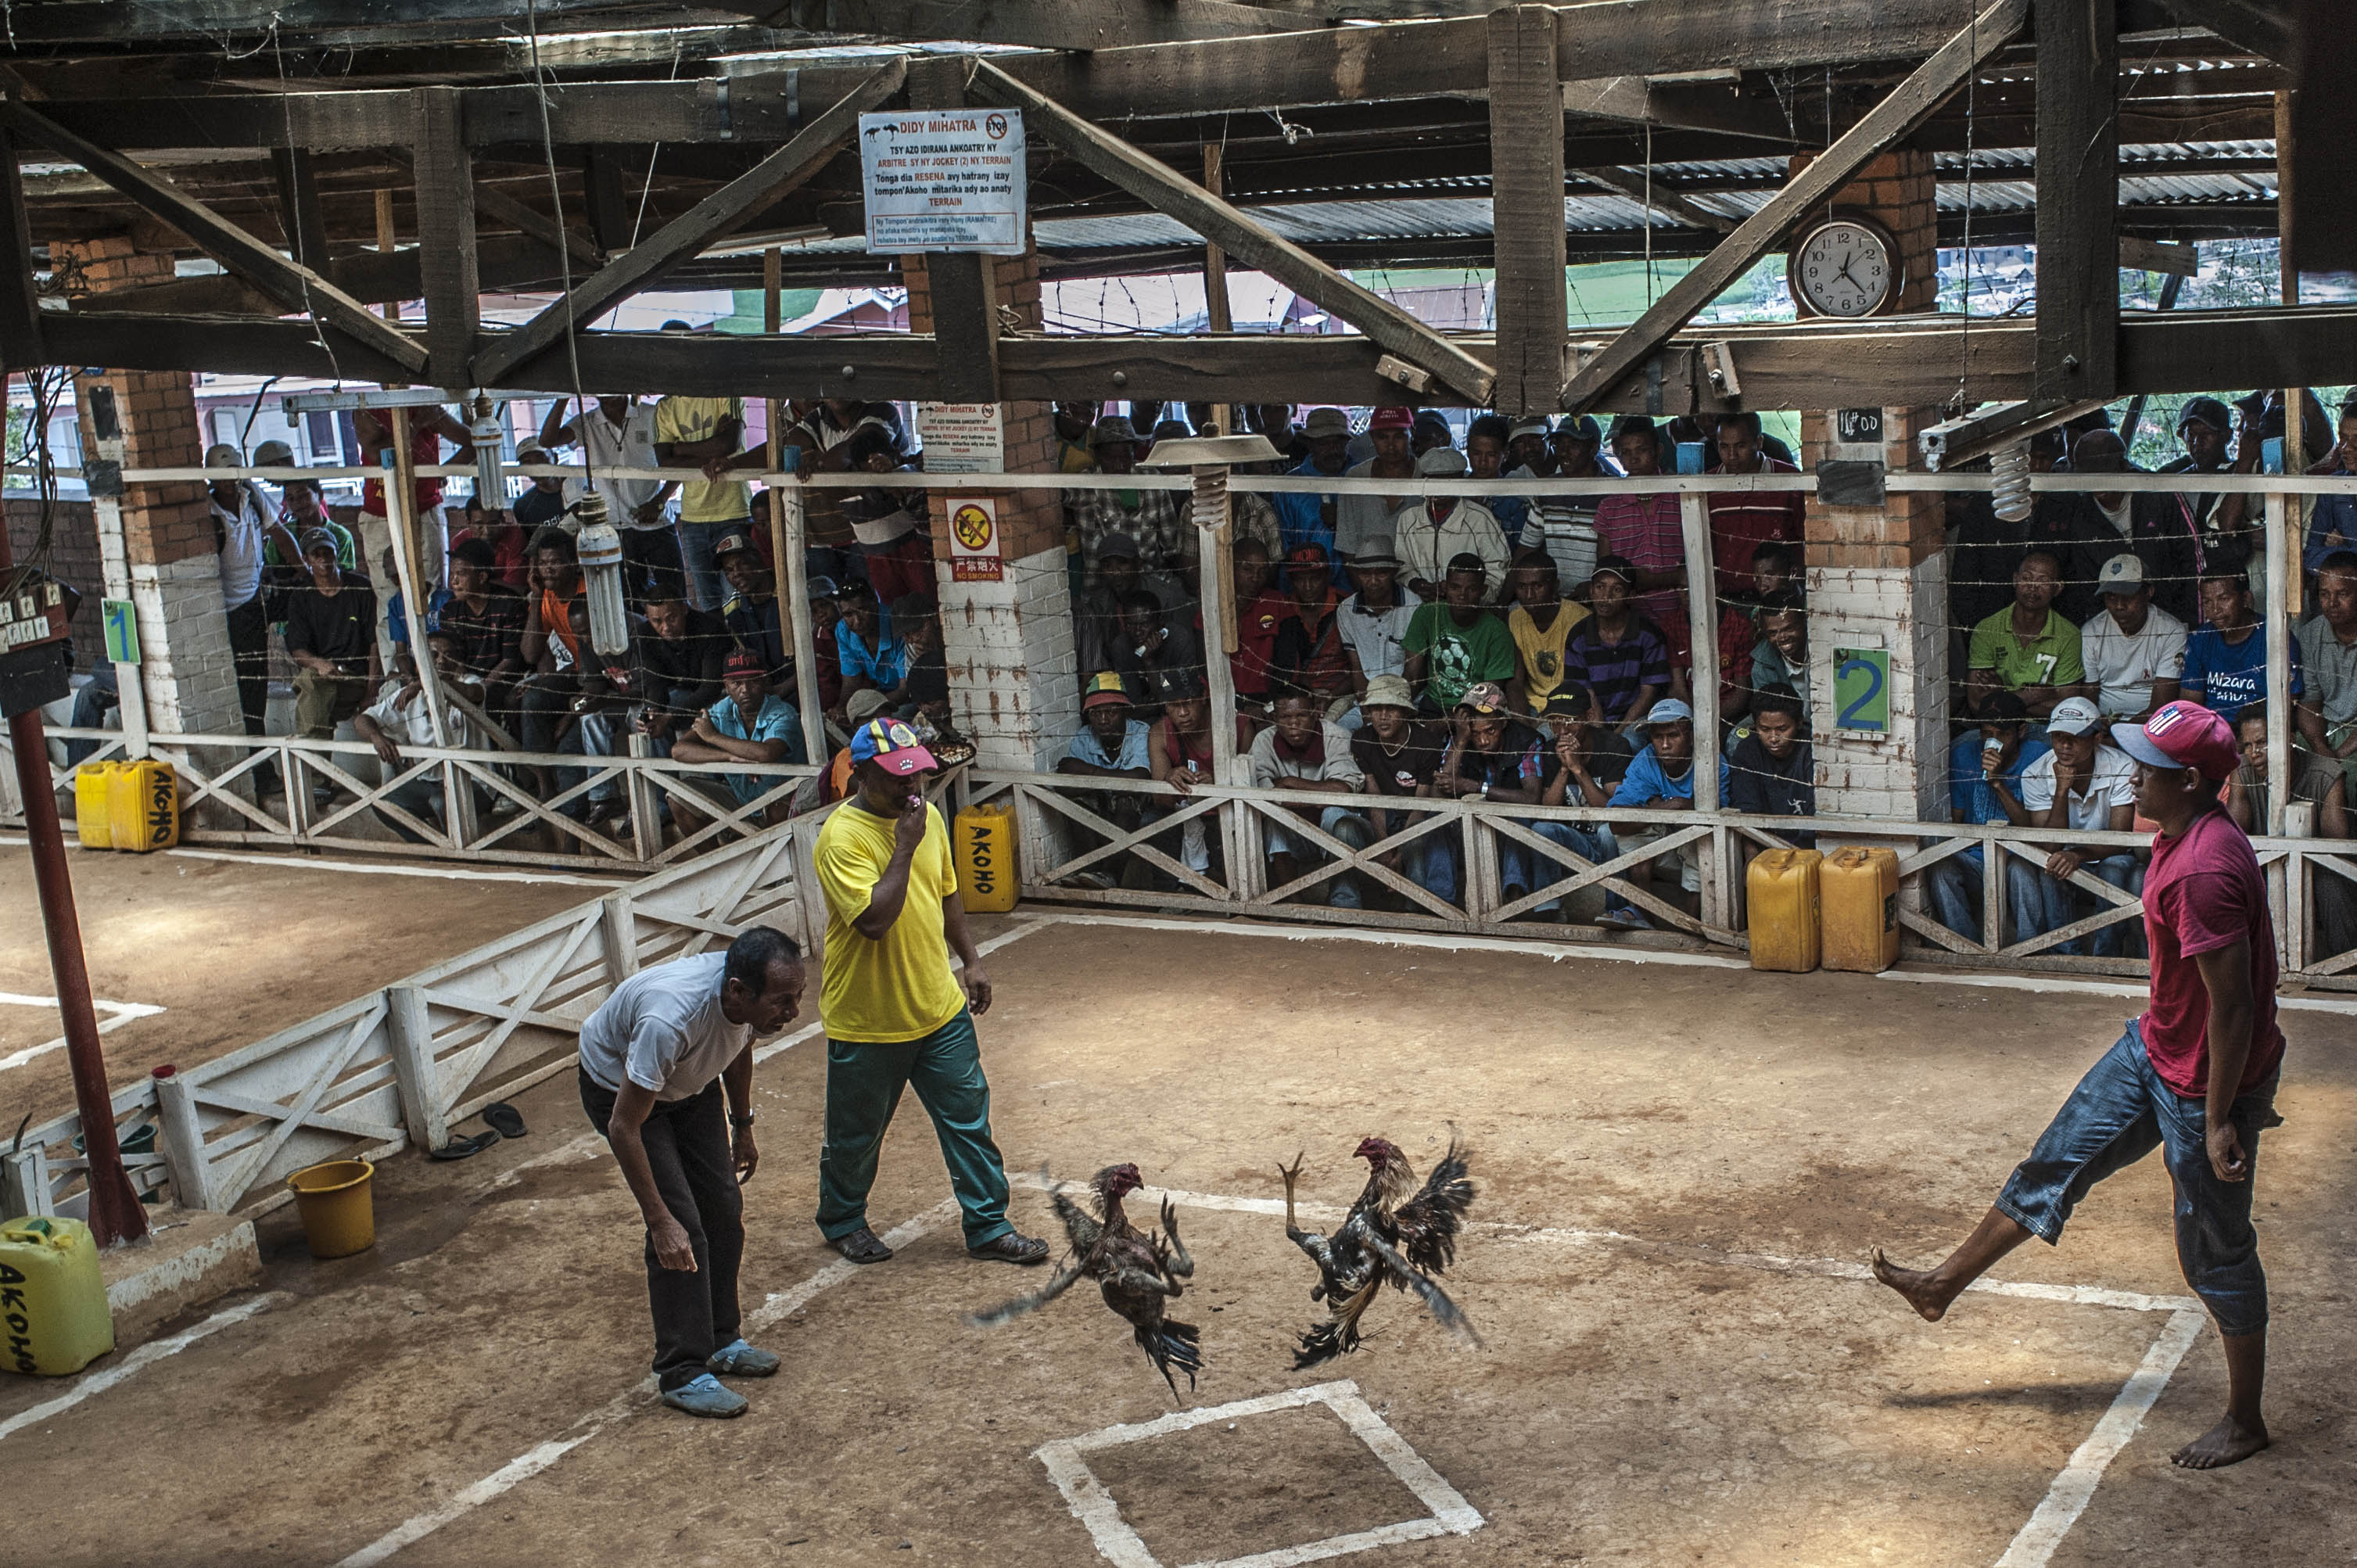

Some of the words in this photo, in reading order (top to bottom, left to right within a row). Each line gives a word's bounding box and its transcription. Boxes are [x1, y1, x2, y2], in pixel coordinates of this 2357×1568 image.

[900, 121, 924, 134] DIDY
[928, 120, 977, 132] MIHATRA
[986, 122, 1006, 131] STOP
[890, 146, 904, 155] TSY
[906, 145, 919, 154] AZO
[920, 145, 948, 154] IDIRANA
[949, 144, 985, 153] ANKOATRY
[987, 143, 997, 152] NY
[878, 159, 907, 167] ARBITRE
[910, 158, 920, 167] SY
[932, 157, 958, 166] JOCKEY
[970, 156, 980, 165] NY
[981, 156, 1011, 165] TERRAIN
[876, 174, 899, 185] Tonga
[901, 173, 913, 182] dia
[914, 172, 945, 181] RESENA
[947, 174, 960, 182] avy
[962, 171, 989, 181] hatrany
[994, 171, 1010, 181] izay
[874, 185, 927, 197] tompon'Akoho
[932, 185, 963, 194] mitarika
[964, 184, 978, 195] ady
[991, 184, 1011, 195] anaty
[928, 198, 962, 207] TERRAIN
[1838, 232, 1850, 243] 12
[1858, 238, 1861, 248] 1
[1812, 251, 1824, 261] 10
[1866, 249, 1875, 260] 2
[1809, 267, 1818, 278] 9
[1871, 266, 1881, 276] 3
[1814, 282, 1823, 293] 8
[1867, 282, 1875, 292] 4
[1826, 296, 1834, 306] 7
[1842, 299, 1851, 310] 6
[1857, 295, 1866, 305] 5
[956, 558, 999, 572] 严禁烟火
[110, 608, 129, 662] 1
[2036, 652, 2058, 684] 7
[2207, 671, 2255, 690] Mizara
[1837, 659, 1883, 730] 2
[970, 826, 995, 894] AKOHO
[0, 1263, 38, 1372] AKOHO
